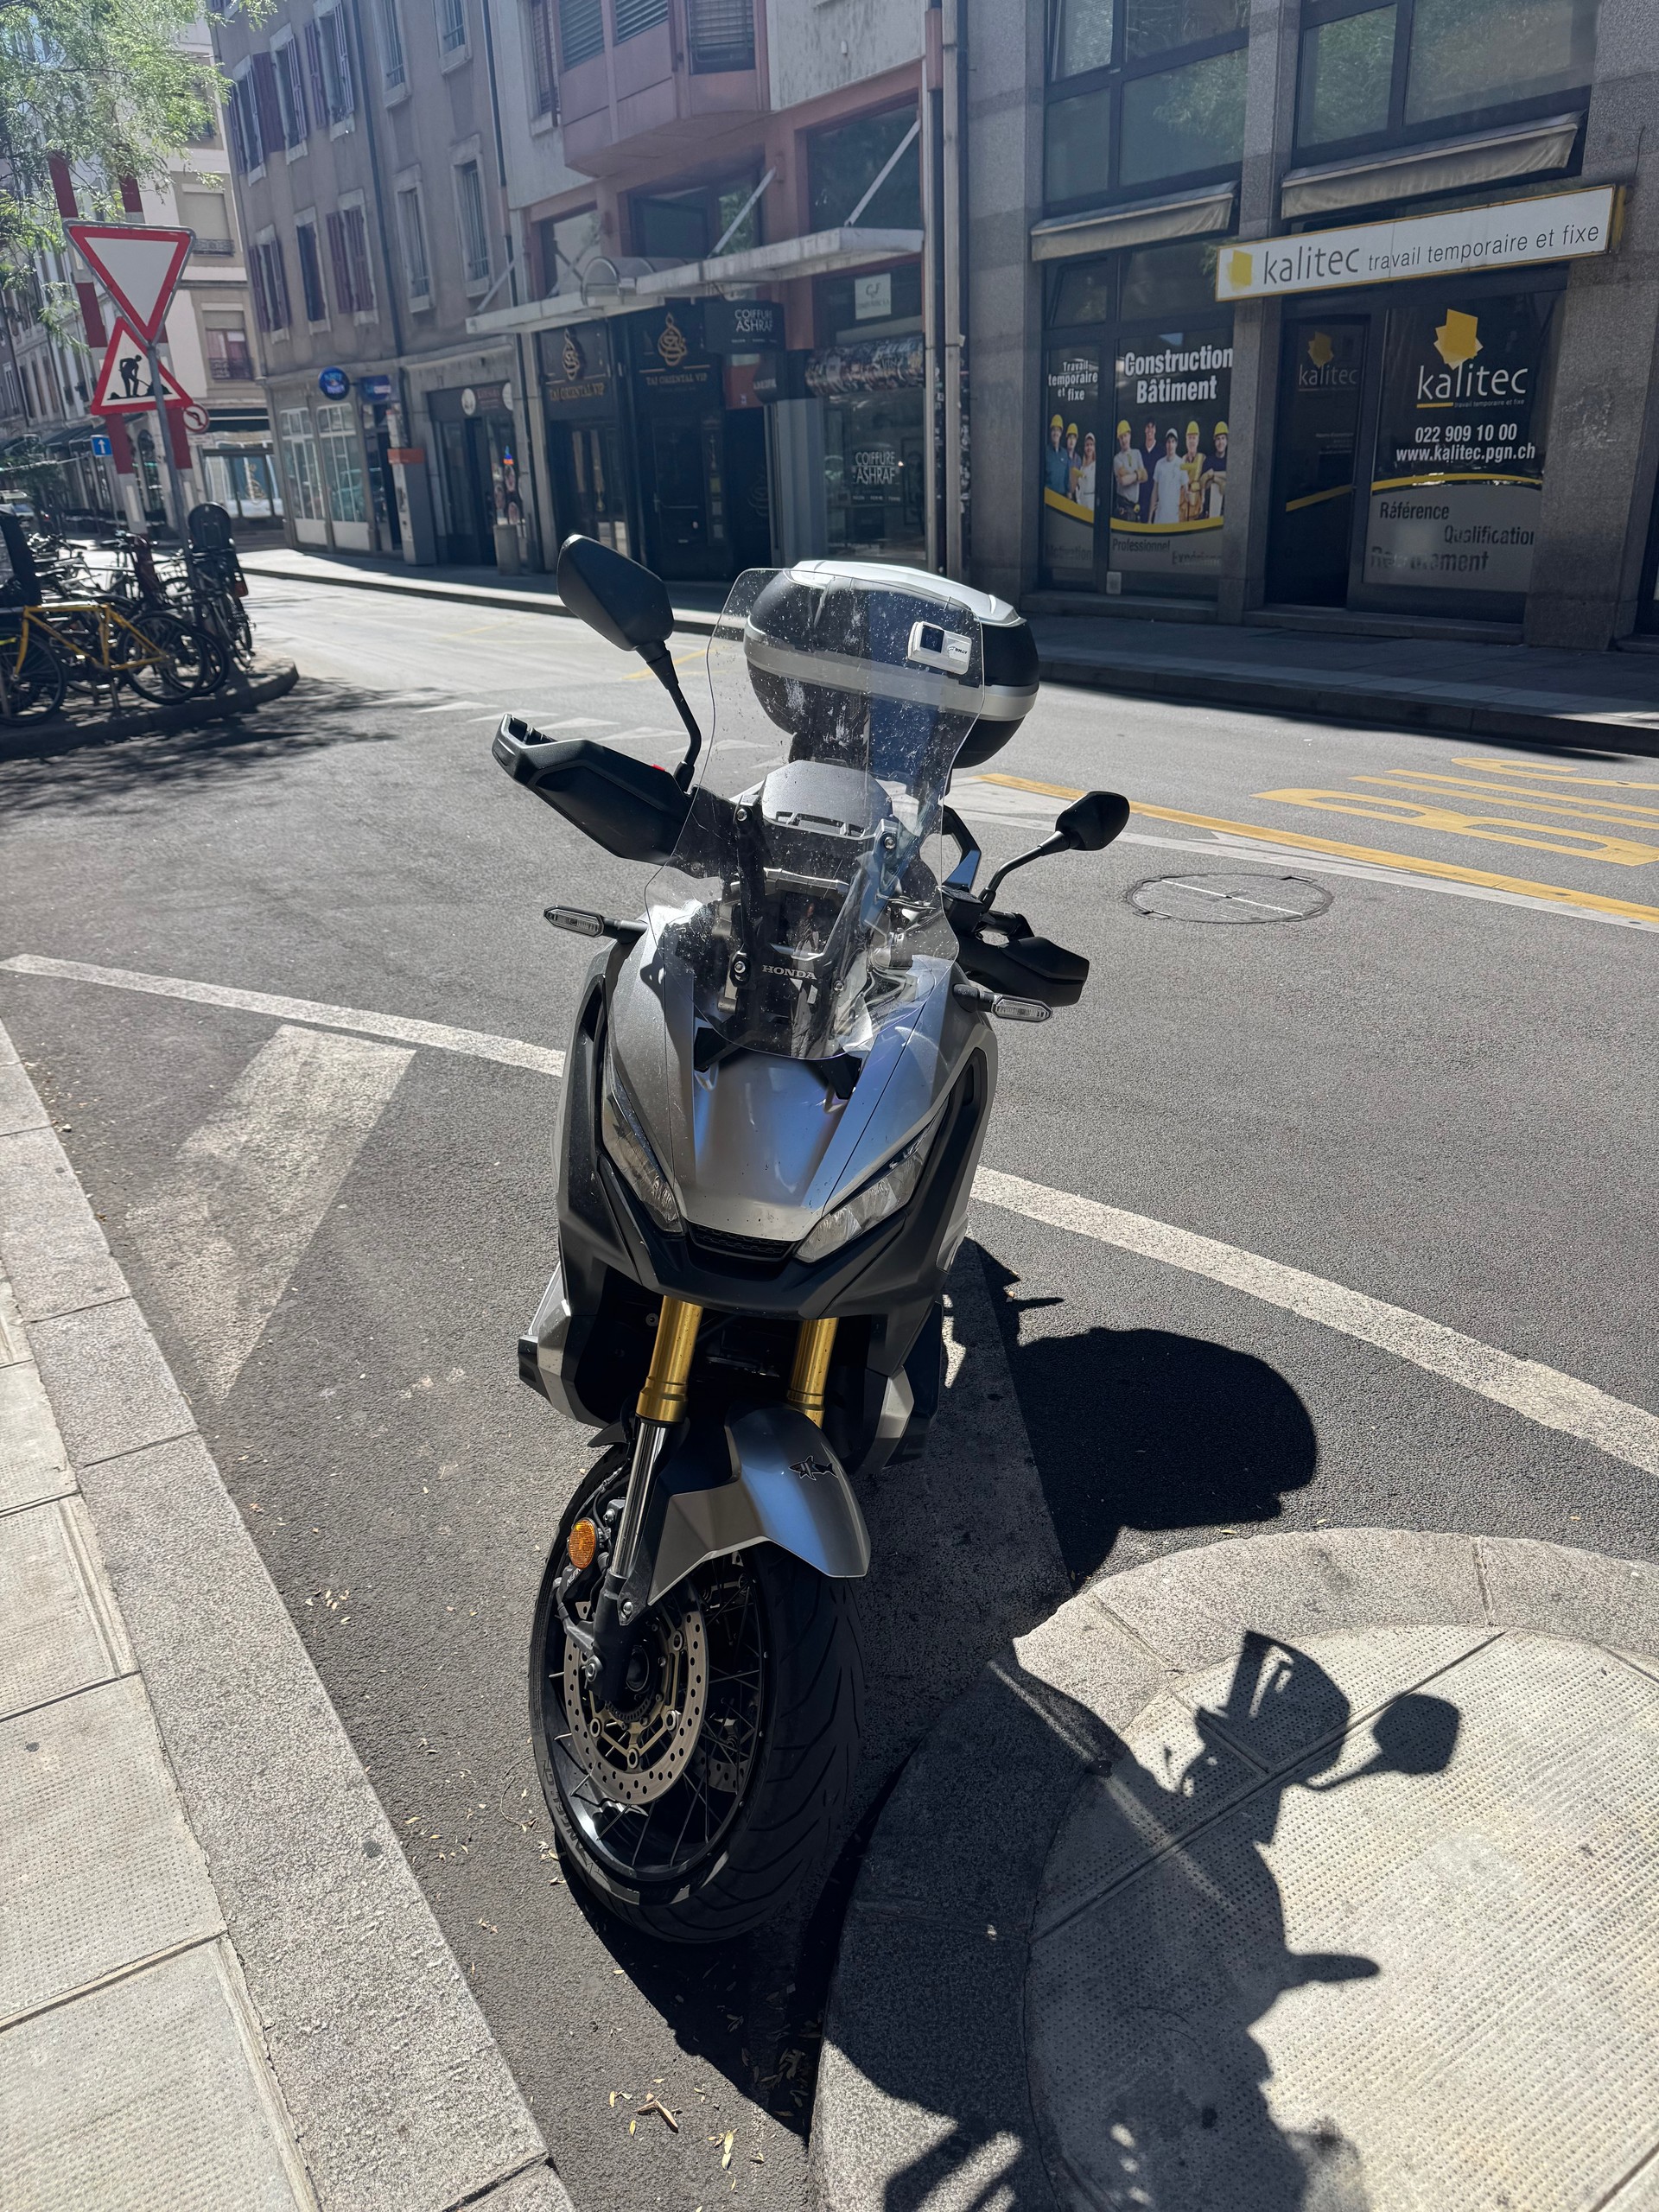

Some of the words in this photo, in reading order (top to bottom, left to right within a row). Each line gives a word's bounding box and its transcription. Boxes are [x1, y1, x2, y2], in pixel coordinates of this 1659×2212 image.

[1263, 245, 1360, 285] kalitec
[1369, 246, 1421, 271] travail
[1427, 233, 1529, 264] temporaire
[1535, 229, 1555, 249] et
[1562, 224, 1599, 245] fixe
[1063, 360, 1090, 372] Travail
[1124, 345, 1234, 378] Construction
[1048, 371, 1099, 388] temporaire
[1299, 364, 1359, 386] kalitec
[1416, 363, 1529, 401] kalitec
[1067, 388, 1085, 402] fixe
[1135, 374, 1218, 404] Bâtiment
[1414, 426, 1440, 443] 022
[1445, 425, 1471, 442] 909
[1477, 424, 1495, 442] 10
[1498, 423, 1518, 441] 00
[855, 451, 895, 466] COIFFURE
[1395, 442, 1536, 464] www.kalitec.pgn.ch
[856, 467, 896, 485] ASHRAF
[1380, 501, 1450, 520] Référence
[1112, 537, 1171, 552] Professionnel
[762, 964, 817, 981] HONDA
